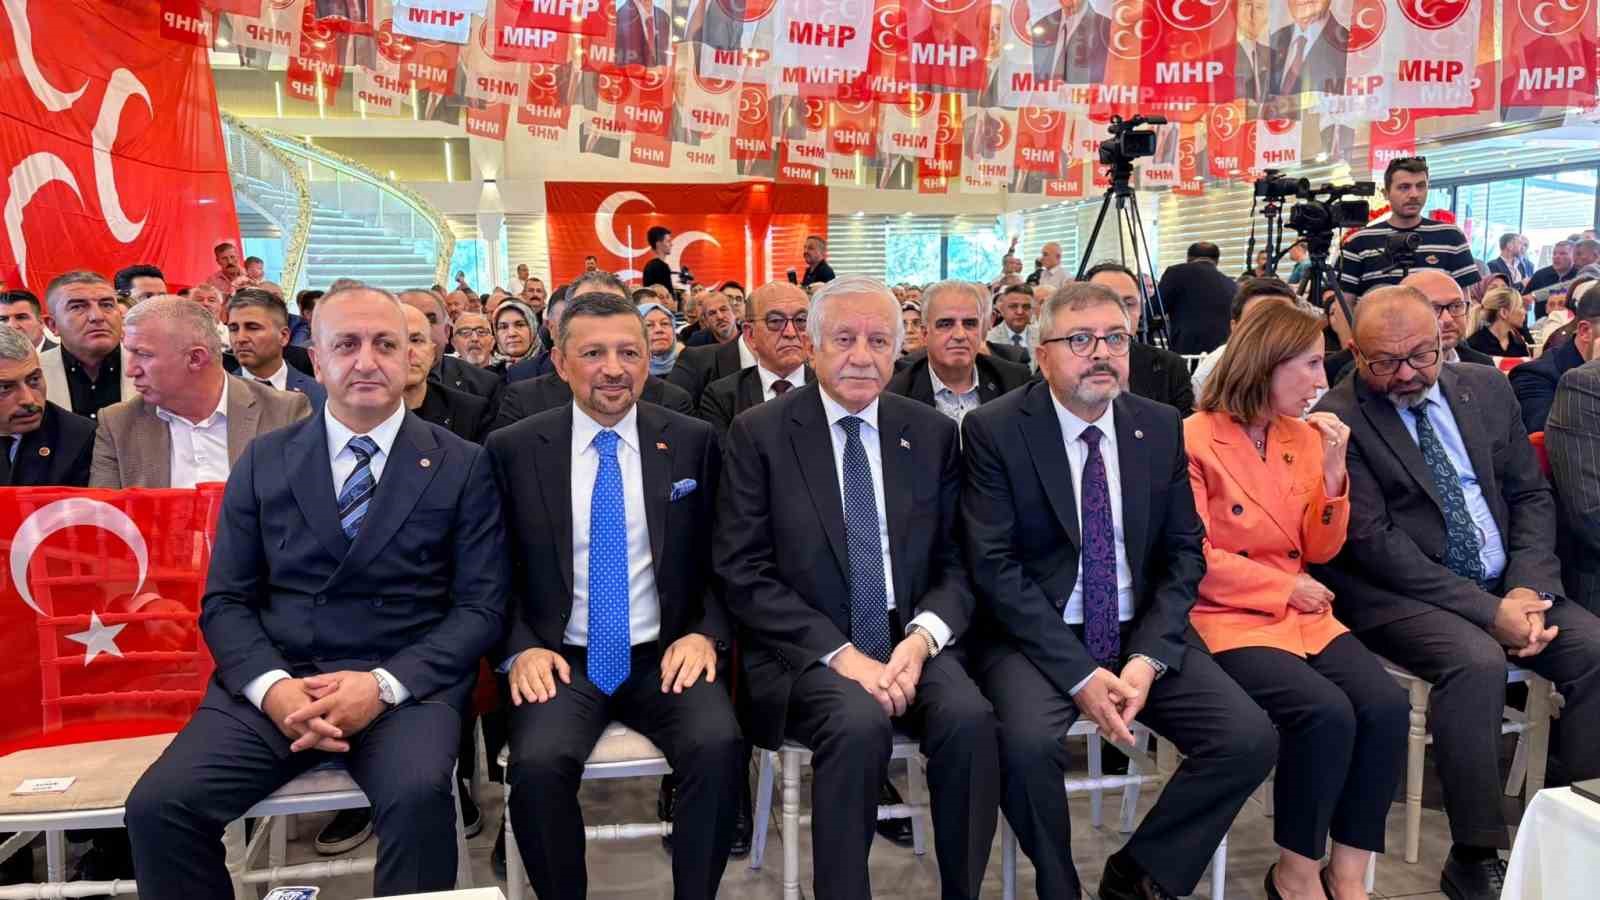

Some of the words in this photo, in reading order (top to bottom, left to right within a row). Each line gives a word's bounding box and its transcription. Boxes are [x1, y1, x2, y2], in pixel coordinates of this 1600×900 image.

[533, 0, 600, 18] MHP
[503, 26, 557, 48] MHP
[789, 21, 856, 48] MHP
[912, 43, 977, 67] MHP
[1155, 62, 1224, 84] MHP
[1399, 60, 1463, 82] MHP
[1518, 66, 1585, 91] MHP
